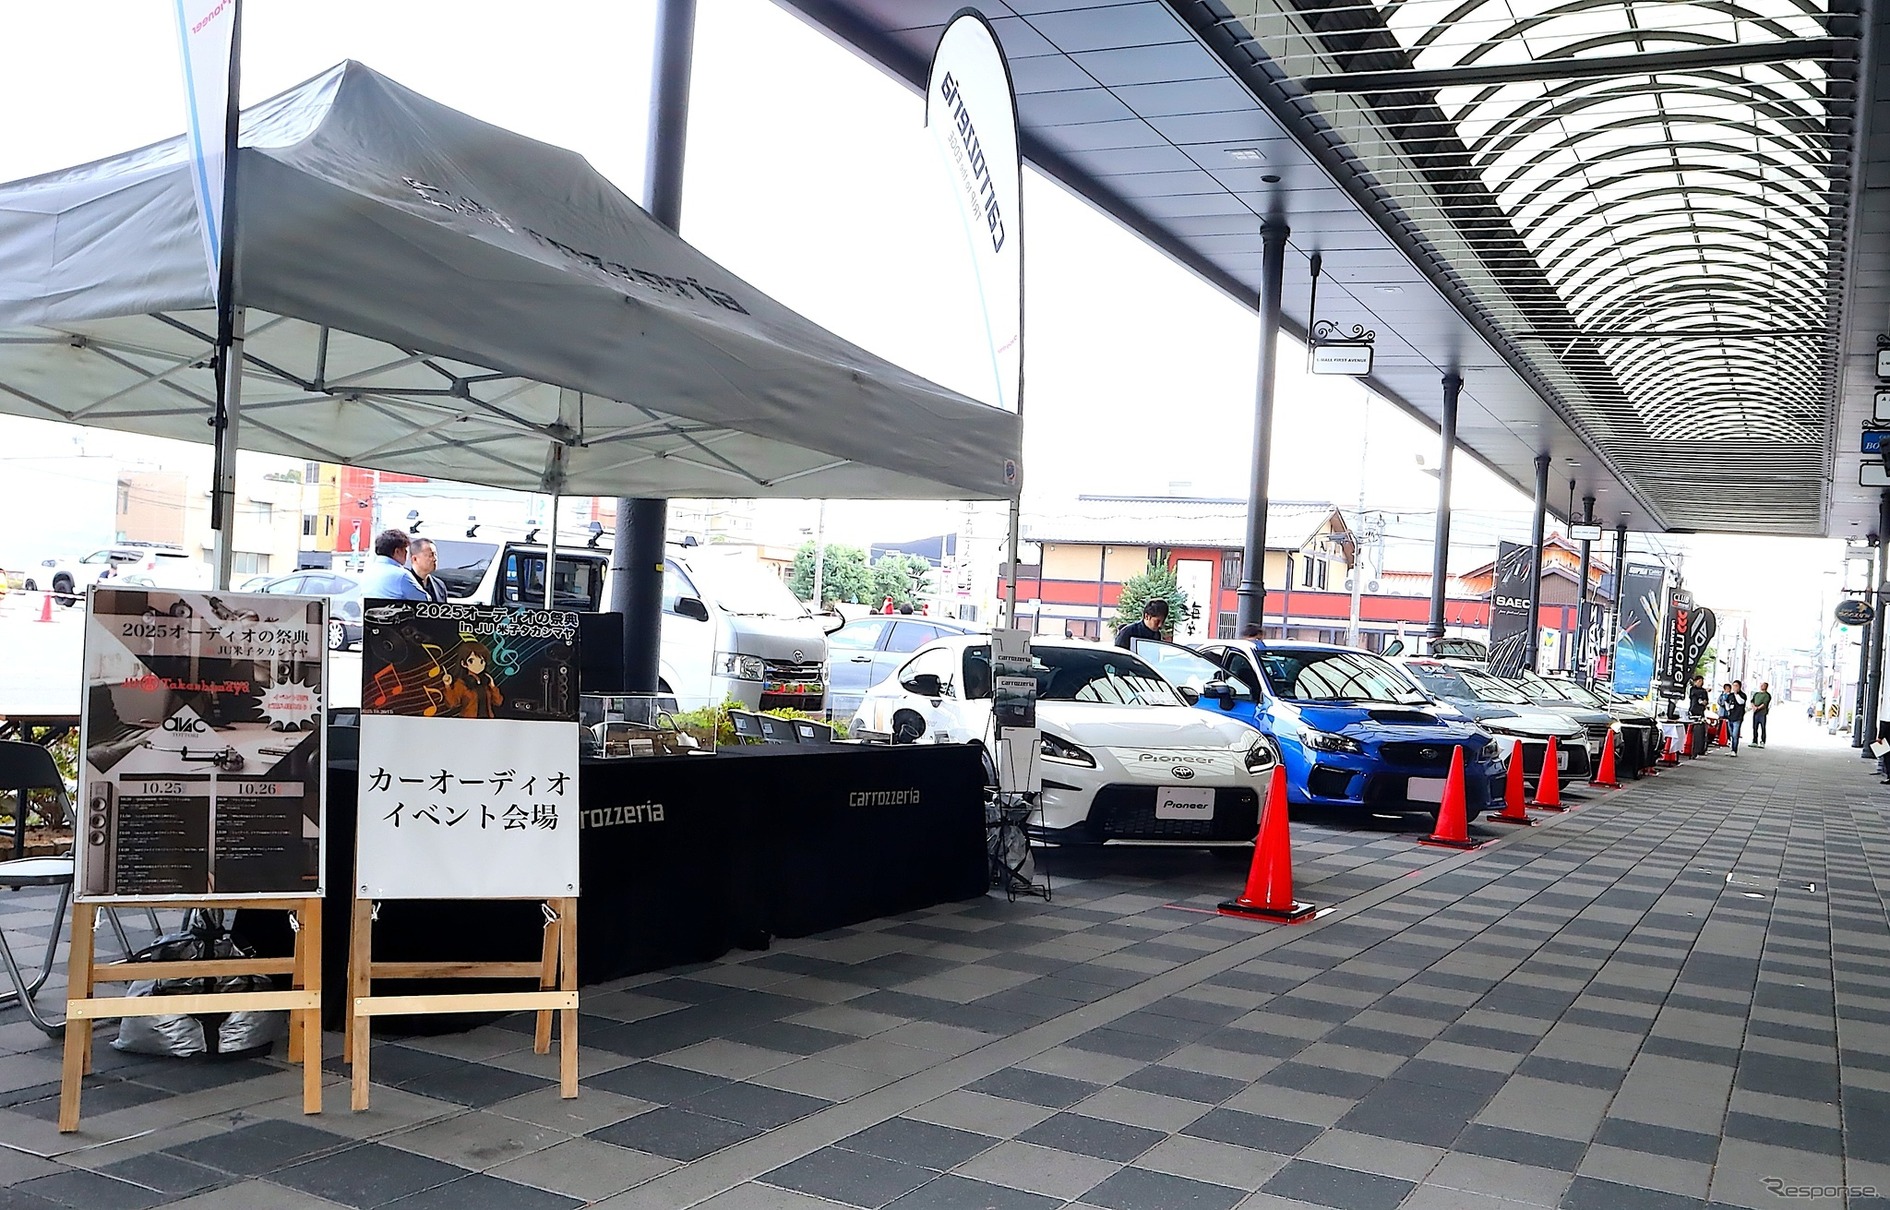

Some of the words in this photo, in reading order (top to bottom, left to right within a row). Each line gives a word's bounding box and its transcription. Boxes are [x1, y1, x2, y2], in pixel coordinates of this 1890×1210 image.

[1496, 595, 1531, 609] SAEC
[415, 603, 580, 627] 2025オーディオの祭典
[122, 622, 310, 646] 2025オーディオの祭典
[998, 654, 1031, 663] carrozzeria
[1674, 633, 1686, 688] morel
[1001, 679, 1034, 687] carrozzeria
[1138, 753, 1215, 764] Pioneer
[142, 782, 182, 795] 10.25
[237, 782, 277, 795] 10.26
[367, 766, 572, 797] カーオーディオ
[849, 787, 920, 807] carrozzeria
[1163, 800, 1208, 810] Pioneer
[382, 802, 559, 831] イベント会場
